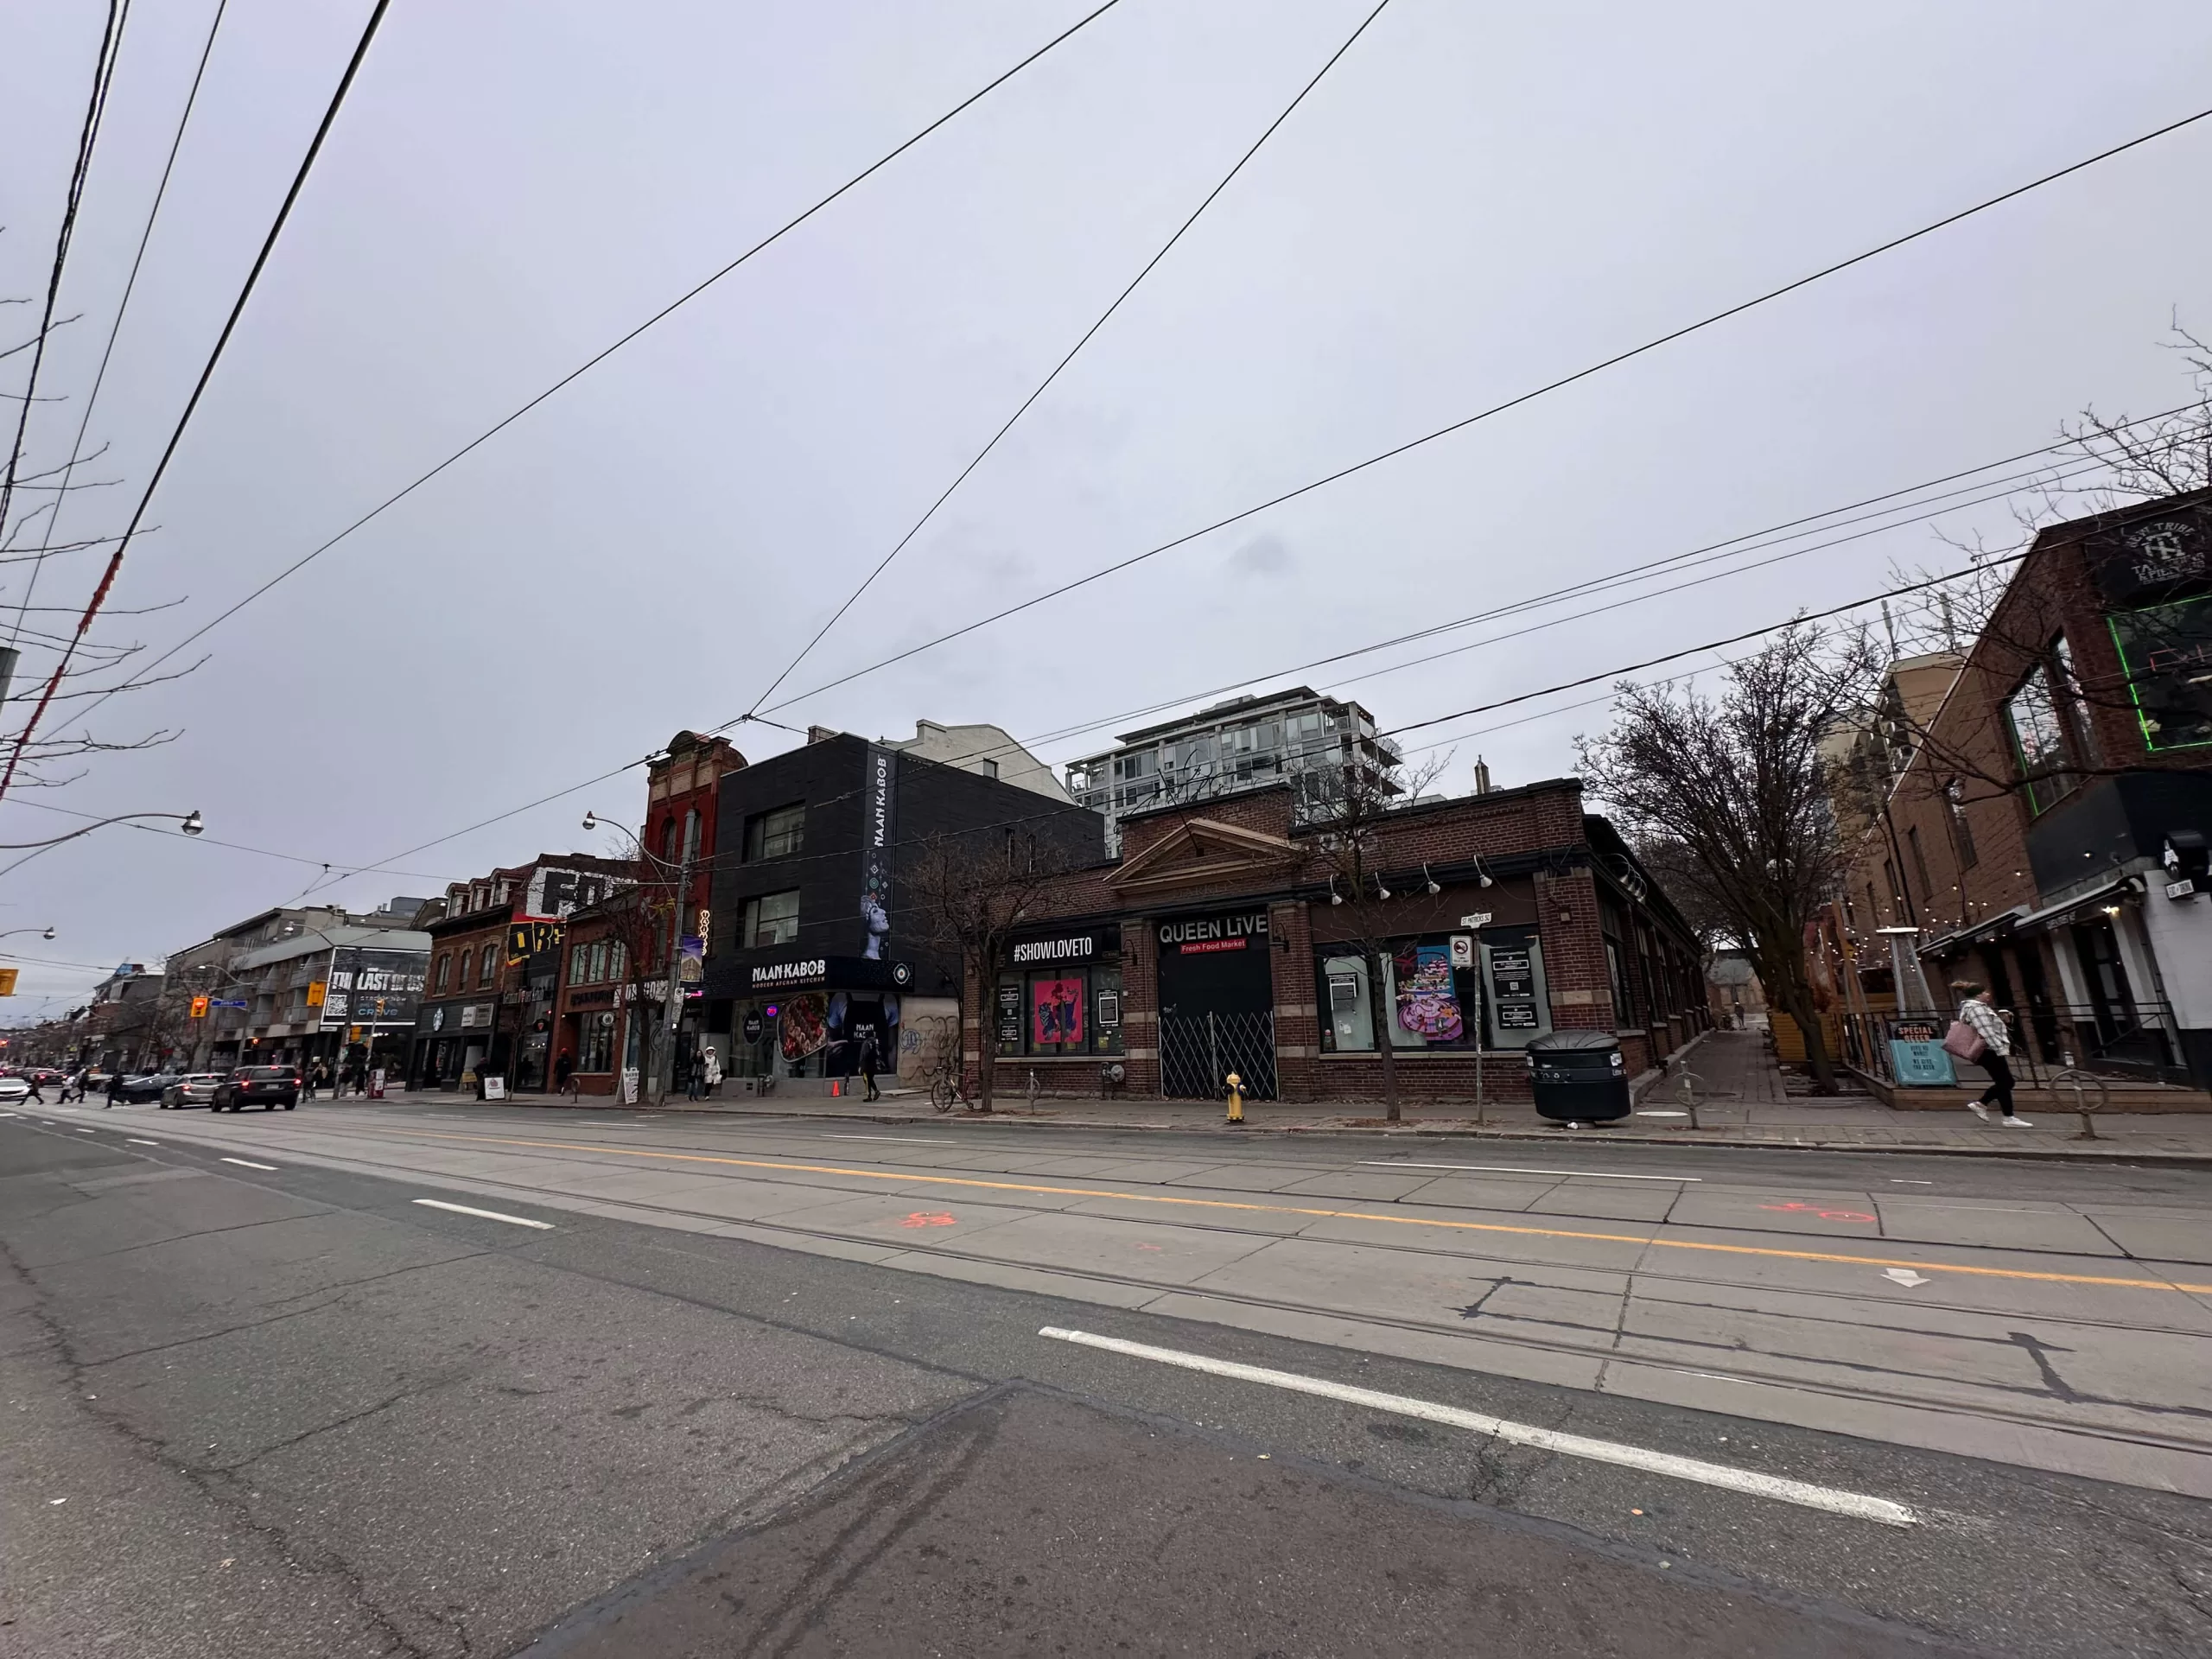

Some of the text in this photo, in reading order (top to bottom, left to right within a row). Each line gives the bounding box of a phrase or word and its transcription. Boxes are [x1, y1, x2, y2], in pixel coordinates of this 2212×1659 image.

[874, 758, 887, 847] NAAN KABOB
[1160, 920, 1221, 944] QUEEN
[1014, 937, 1092, 962] #SHOWLOVETO
[1202, 942, 1219, 950] Food
[1221, 939, 1246, 948] Market
[753, 959, 825, 982] NAAN KABOB
[332, 971, 354, 990] TH
[357, 972, 391, 991] LAST
[799, 976, 825, 984] KITCHEN
[855, 1023, 874, 1032] NAAN
[1898, 1026, 1935, 1034] SPECIAL
[1904, 1034, 1930, 1043] OFFER
